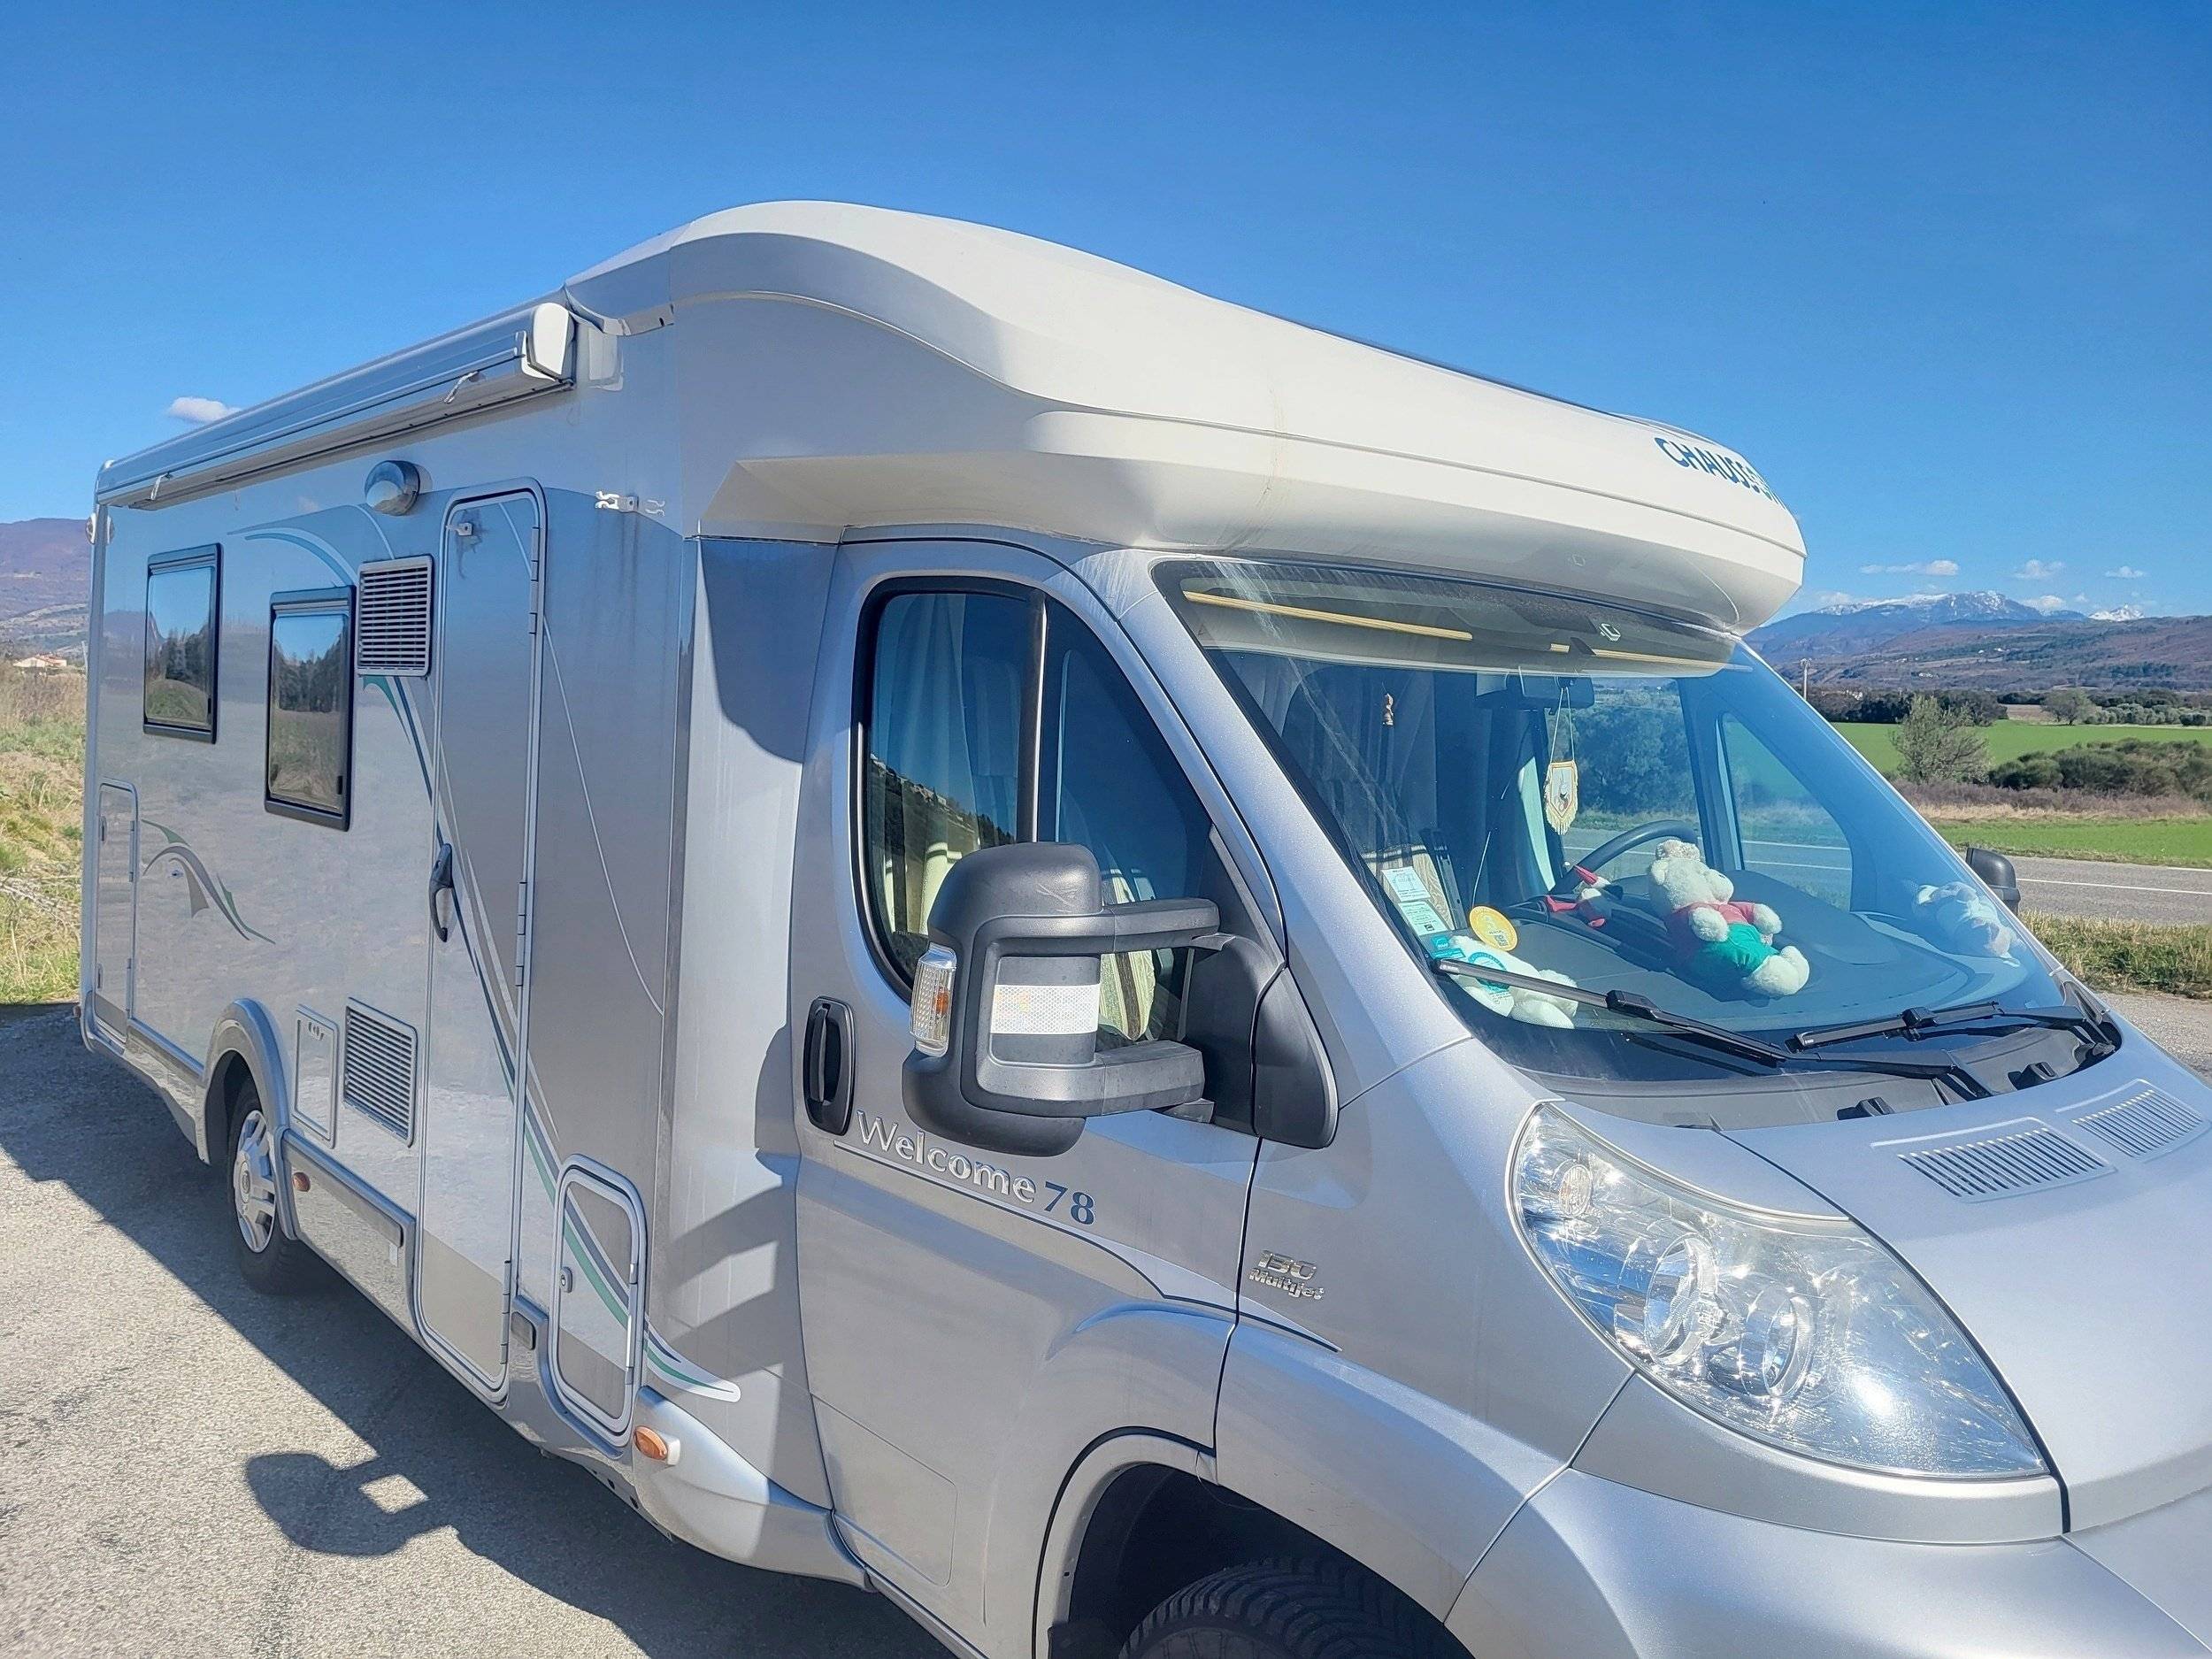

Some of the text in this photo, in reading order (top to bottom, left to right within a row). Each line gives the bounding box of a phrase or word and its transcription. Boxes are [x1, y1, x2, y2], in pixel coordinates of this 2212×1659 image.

[856, 1110, 1095, 1225] Welcome 78
[1248, 1268, 1325, 1300] Multijet
